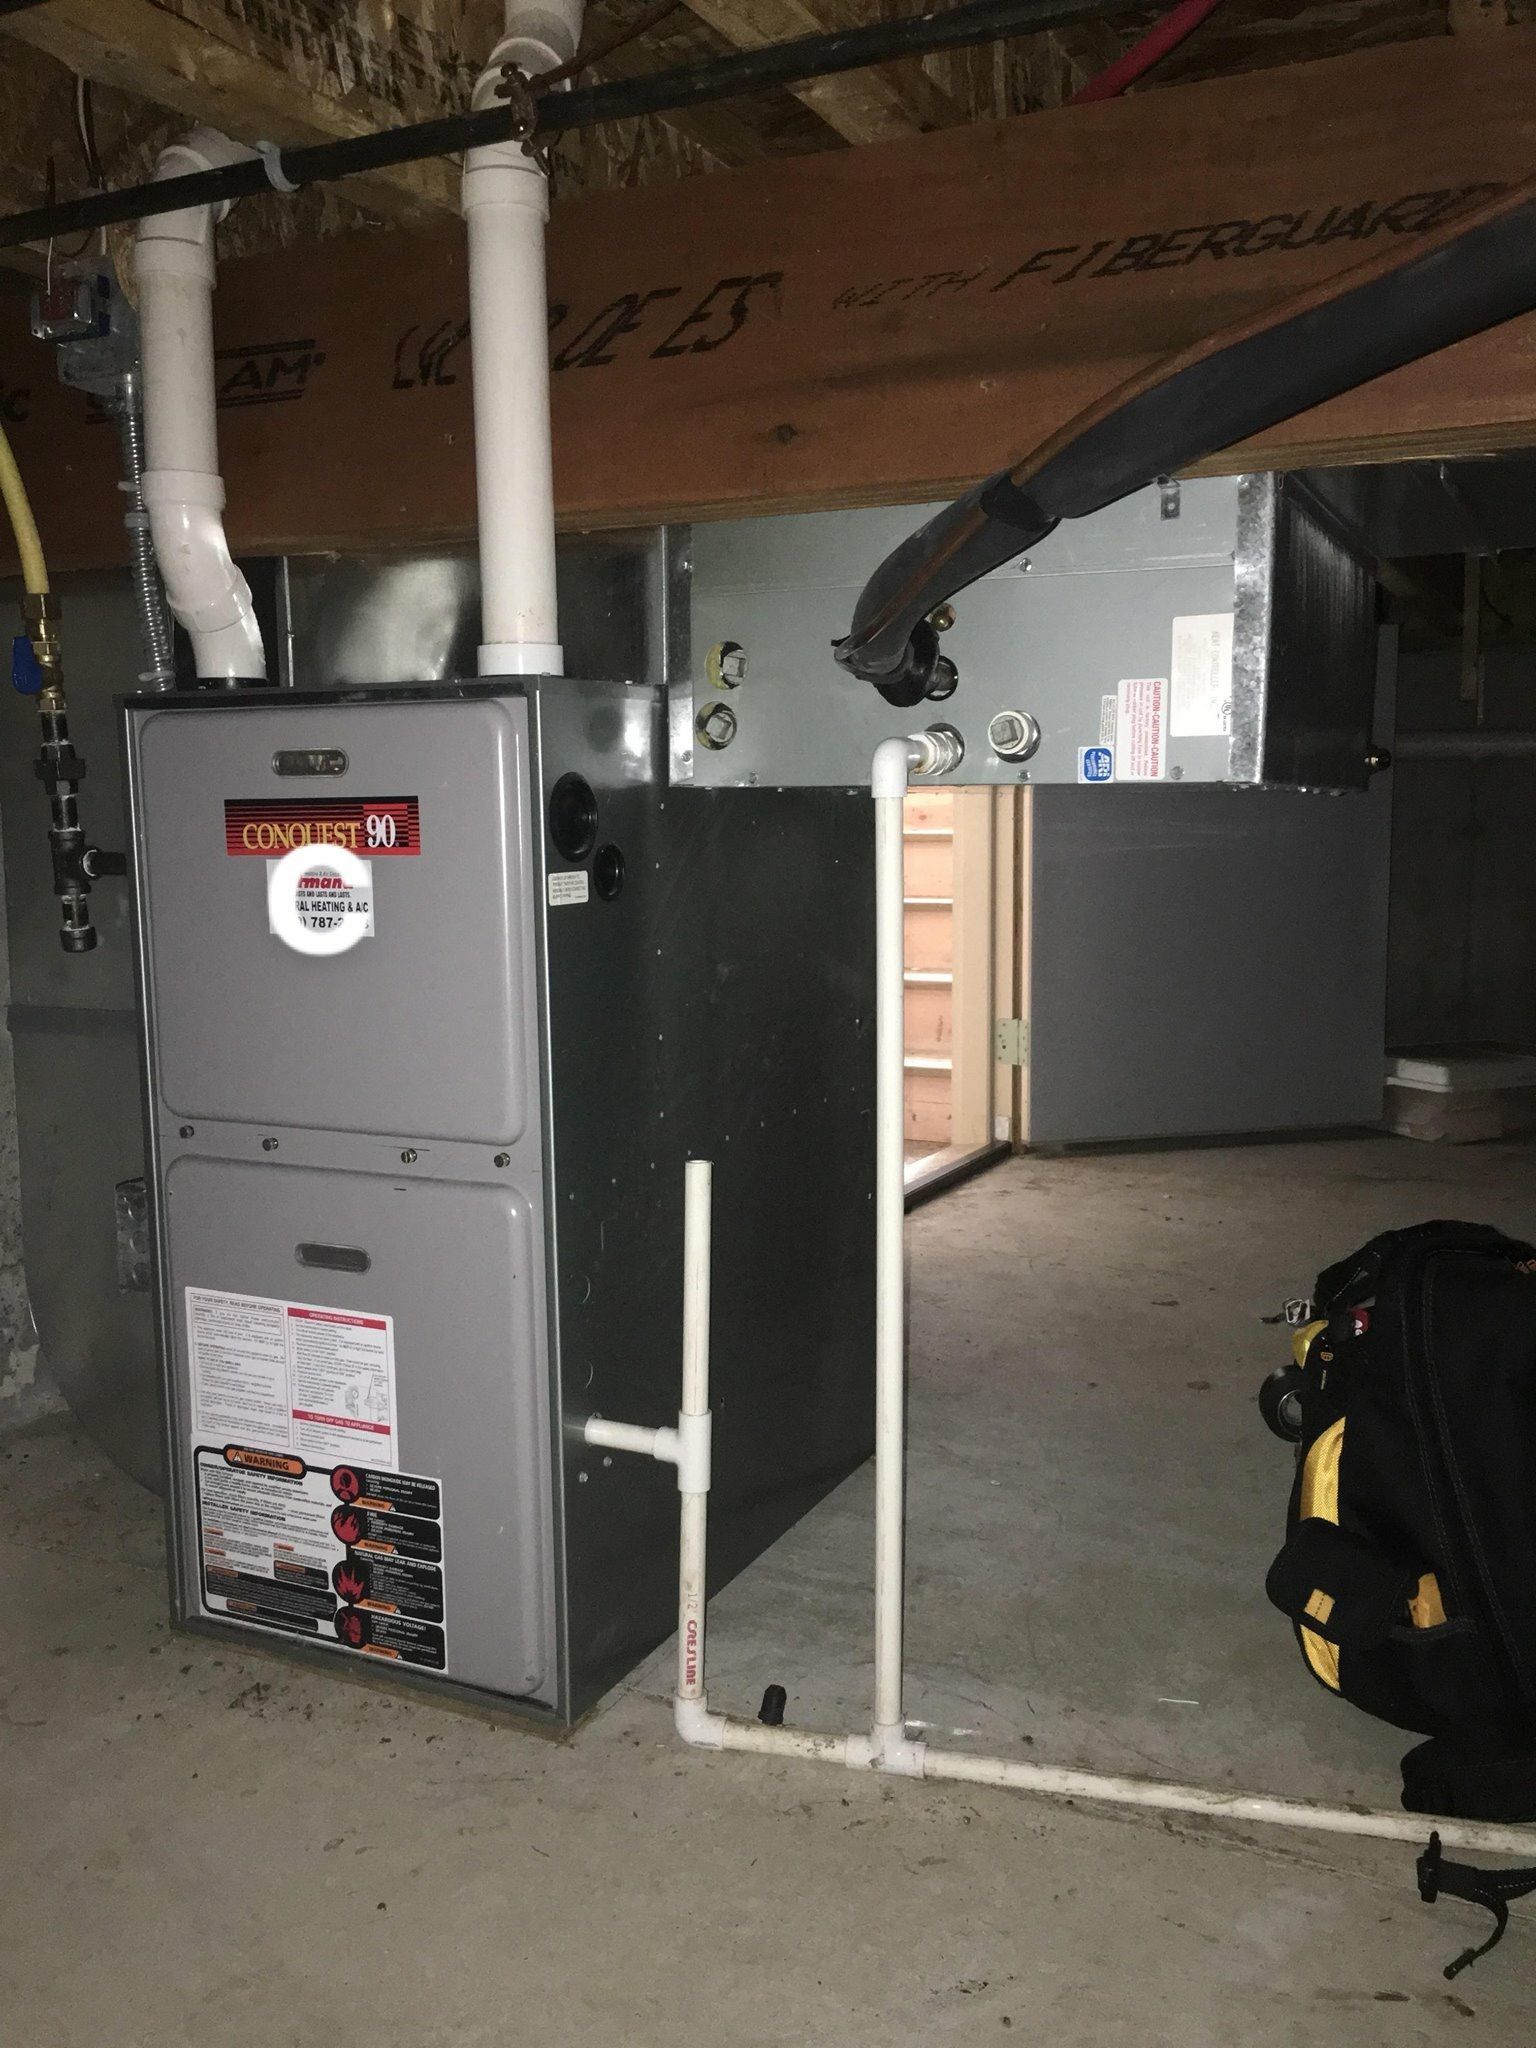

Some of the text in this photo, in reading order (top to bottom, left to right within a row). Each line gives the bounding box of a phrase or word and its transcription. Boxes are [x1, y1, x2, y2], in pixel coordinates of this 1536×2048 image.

[990, 182, 1511, 293] FIBERGUARD
[242, 814, 396, 850] CONQUEST 90
[311, 901, 346, 914] HEATING
[347, 903, 354, 913] &
[244, 1454, 290, 1471] WARNING
[247, 1470, 266, 1480] SAFETY
[267, 1474, 303, 1486] INFORMATION
[202, 1500, 286, 1521] INSTALLER SAFETY INFORMATION
[686, 1619, 698, 1686] CRESLINE
